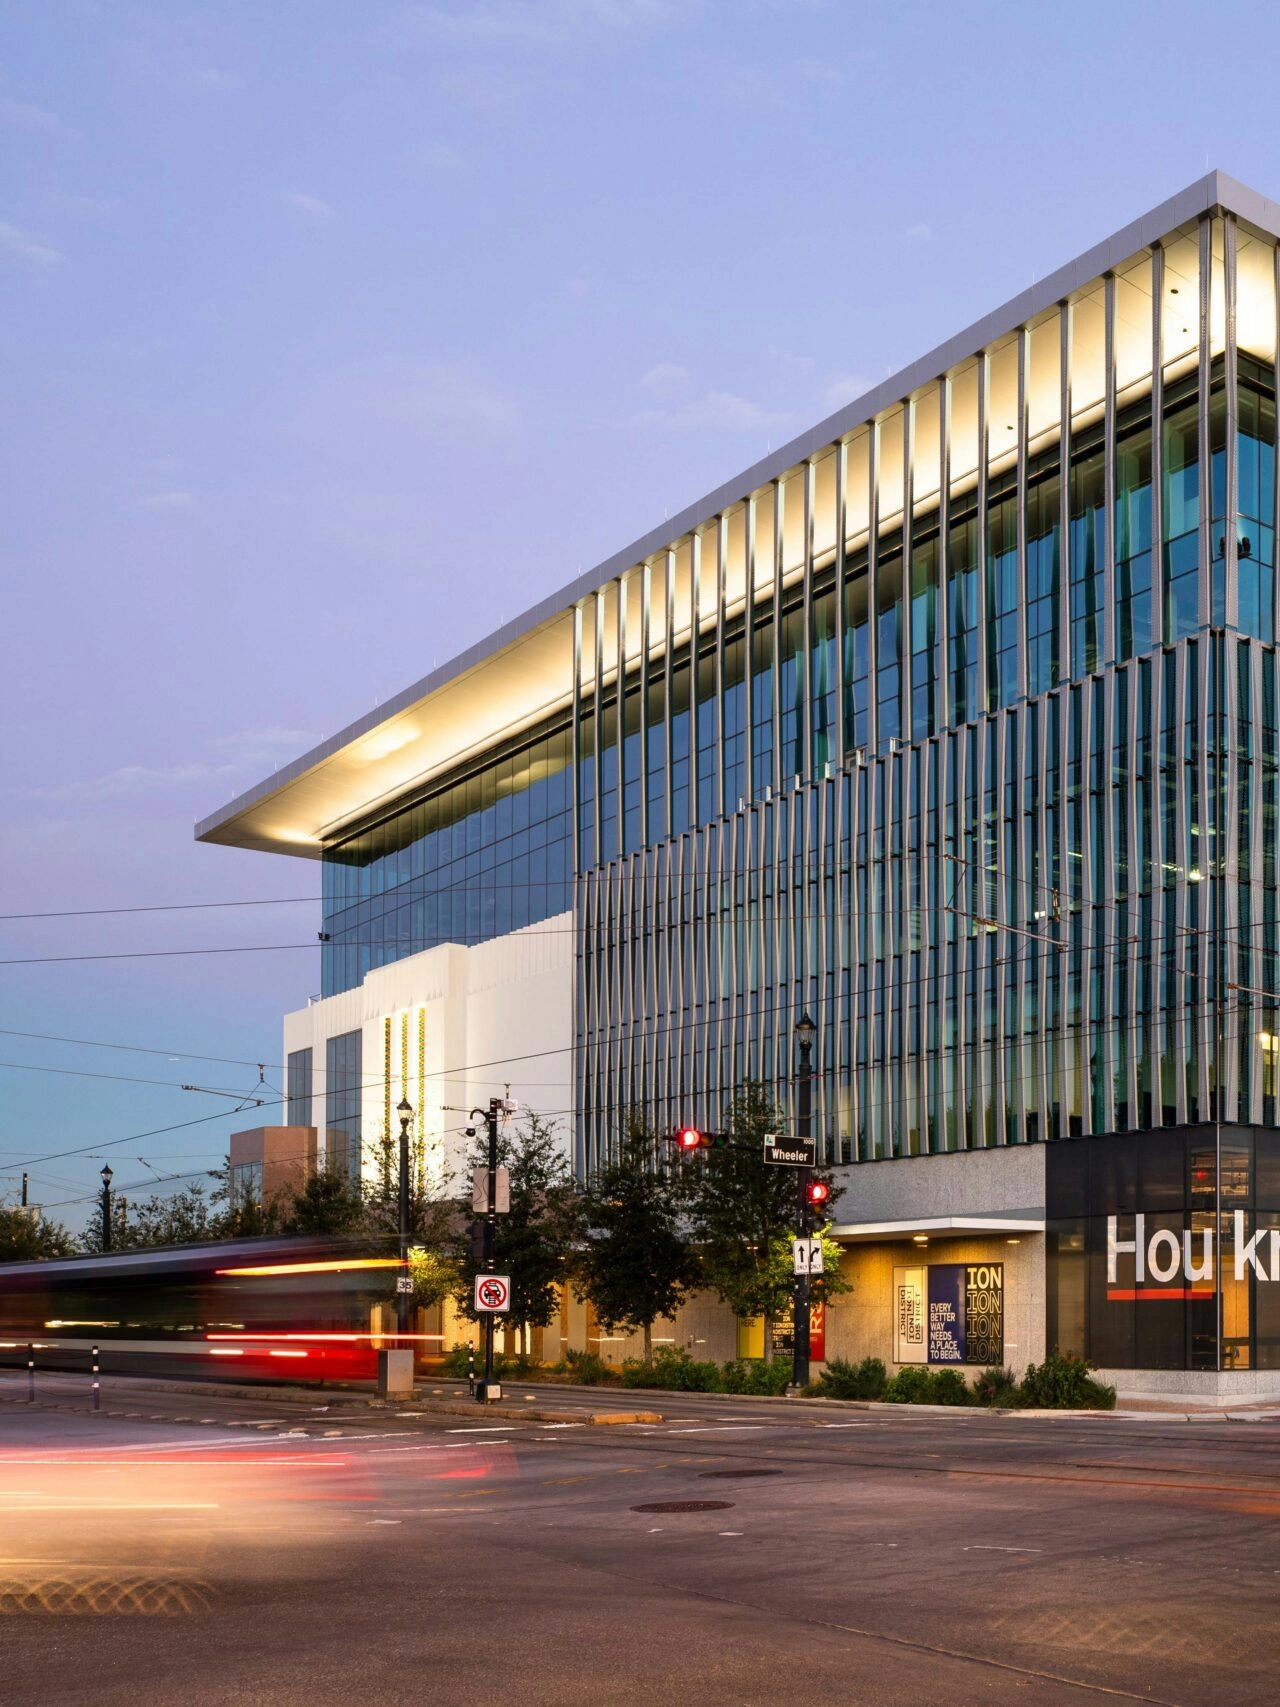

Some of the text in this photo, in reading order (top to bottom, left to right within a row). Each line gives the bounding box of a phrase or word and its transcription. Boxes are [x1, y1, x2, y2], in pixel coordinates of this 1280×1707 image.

[771, 1148, 808, 1162] Wheeler
[1107, 1213, 1213, 1284] Hou
[967, 1266, 1002, 1290] ION
[399, 1281, 412, 1289] 35
[930, 1303, 951, 1312] EVERY
[967, 1290, 1002, 1314] ION
[930, 1312, 955, 1322] BETTER
[930, 1321, 945, 1331] WAY
[967, 1314, 1002, 1338] ION
[930, 1330, 952, 1340] NEEDS
[930, 1340, 958, 1350] A PLACE
[967, 1338, 1002, 1362] ION
[930, 1349, 962, 1360] TO BEGIN.
